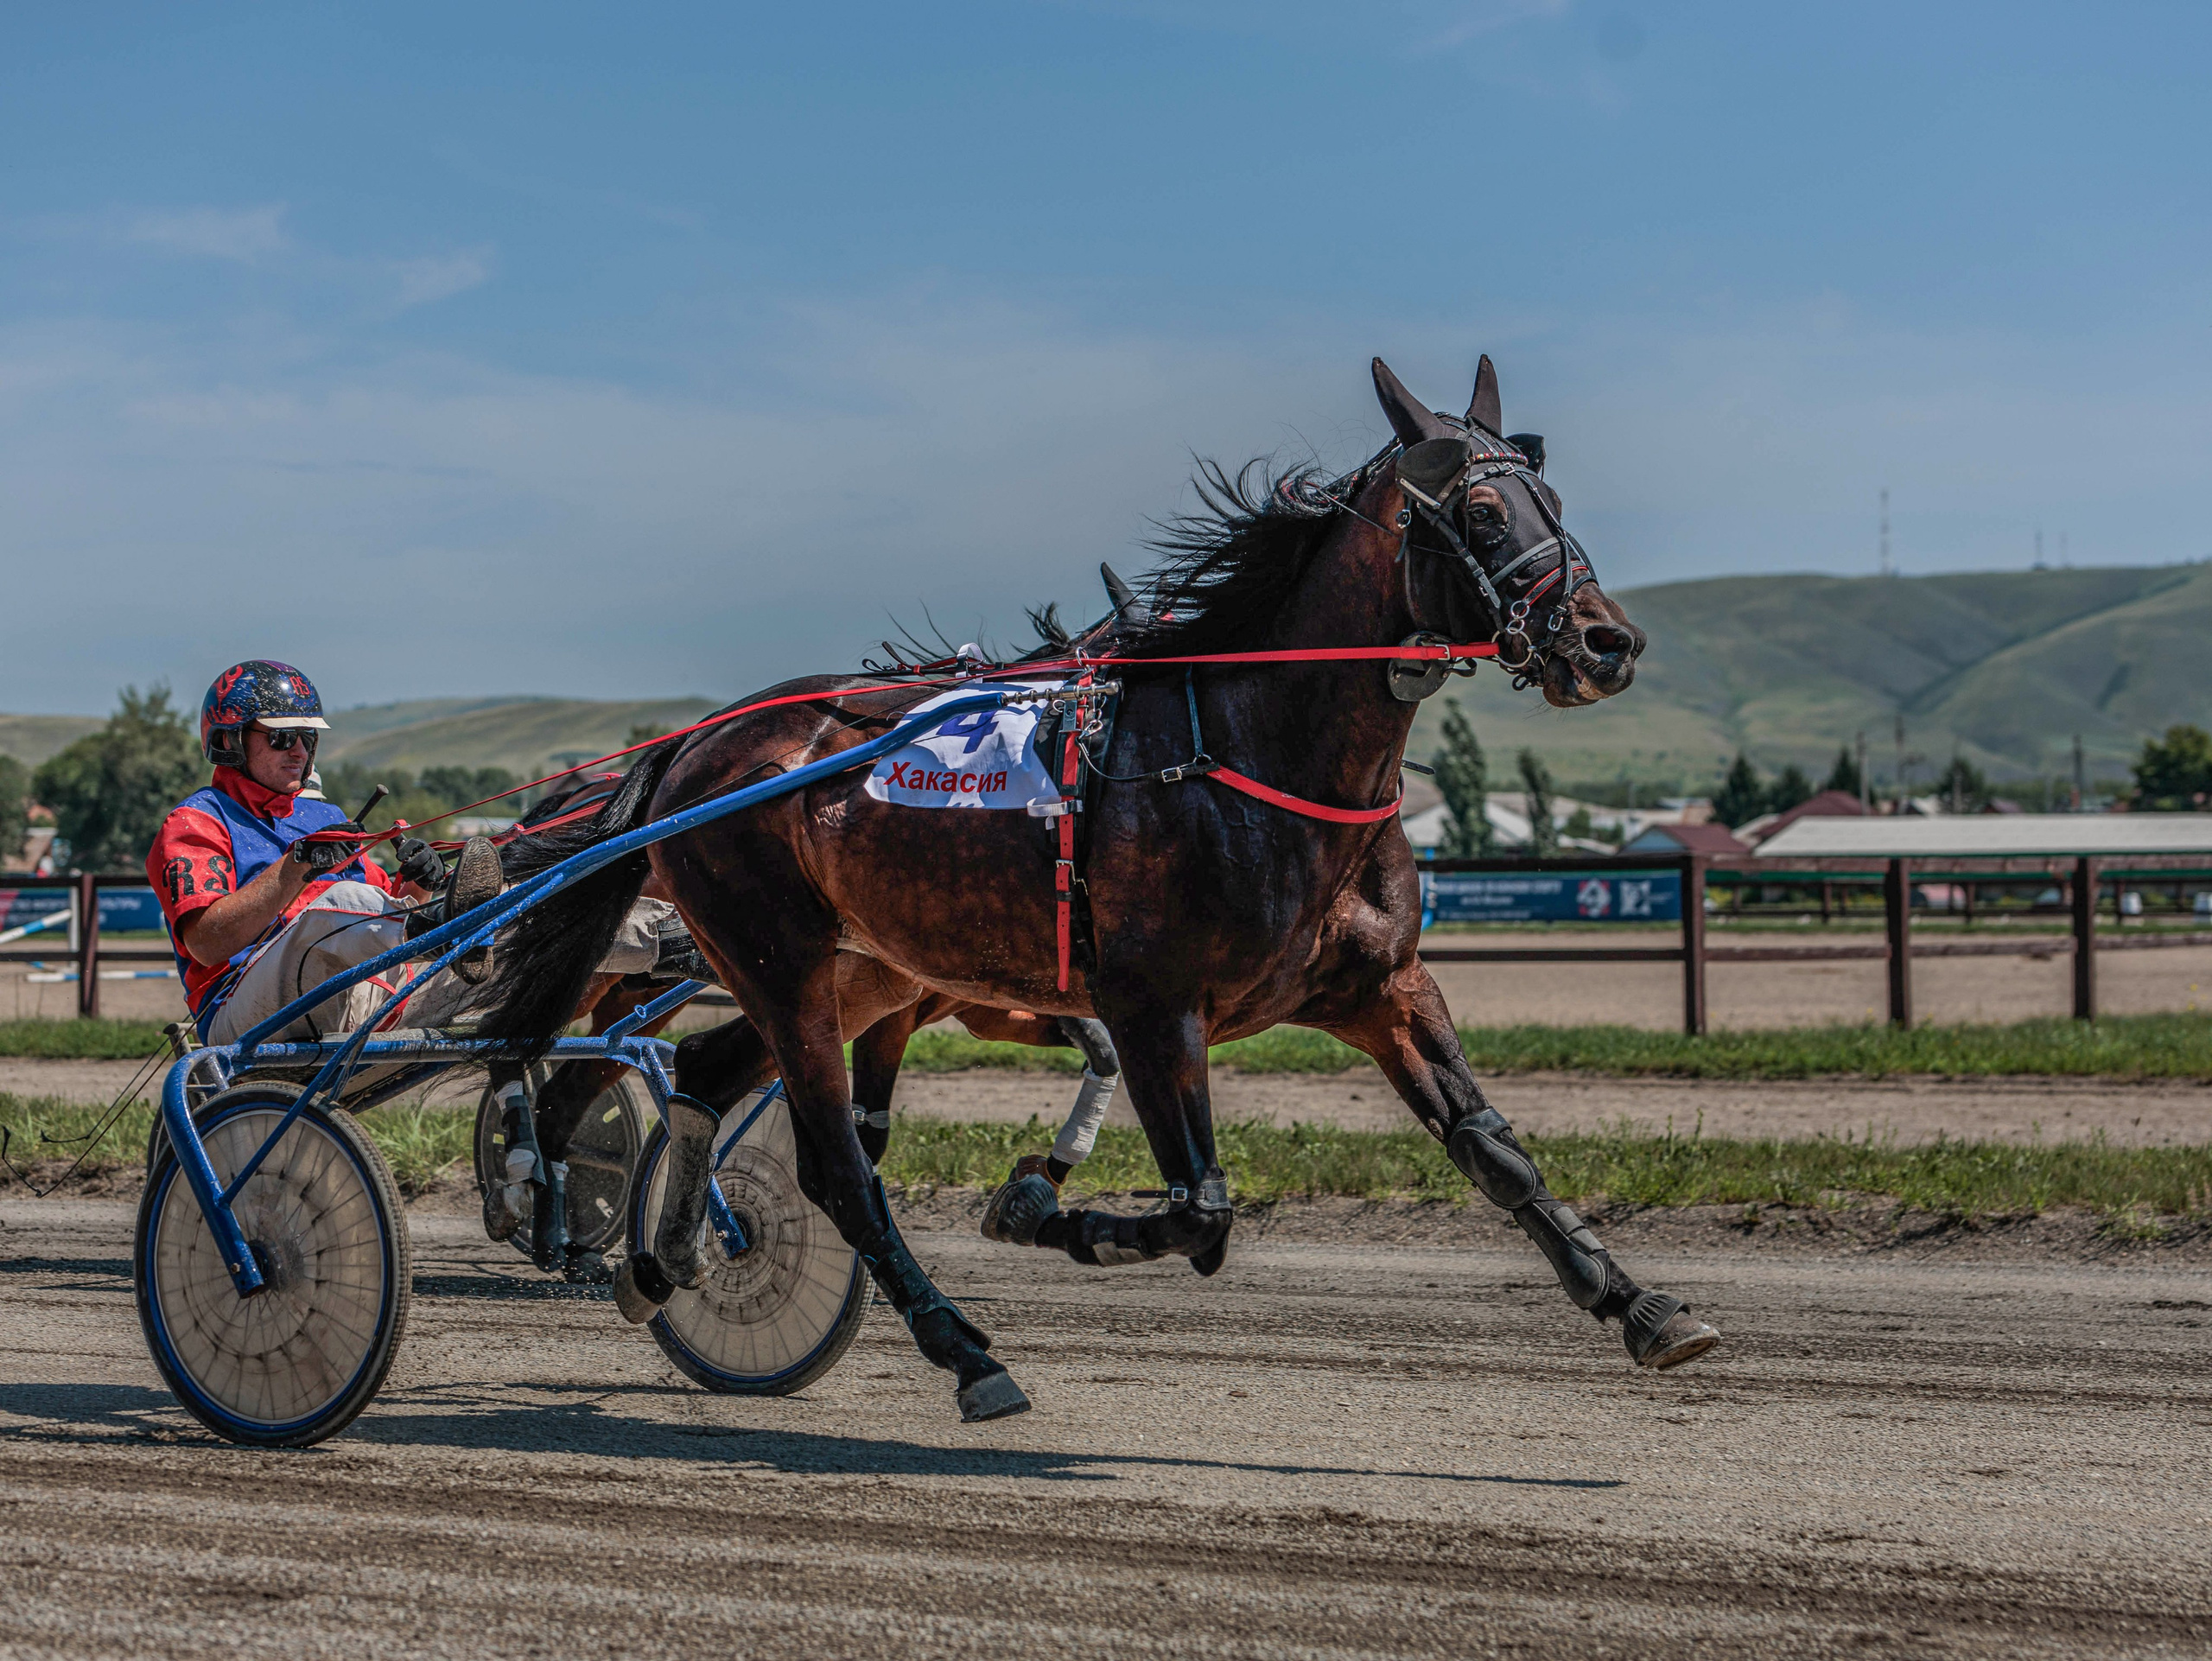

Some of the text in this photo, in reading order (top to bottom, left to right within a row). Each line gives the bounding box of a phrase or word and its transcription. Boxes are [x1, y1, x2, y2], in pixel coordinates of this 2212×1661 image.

[289, 676, 310, 696] RS
[936, 710, 1000, 754] 4
[883, 761, 1007, 793] Хакасия
